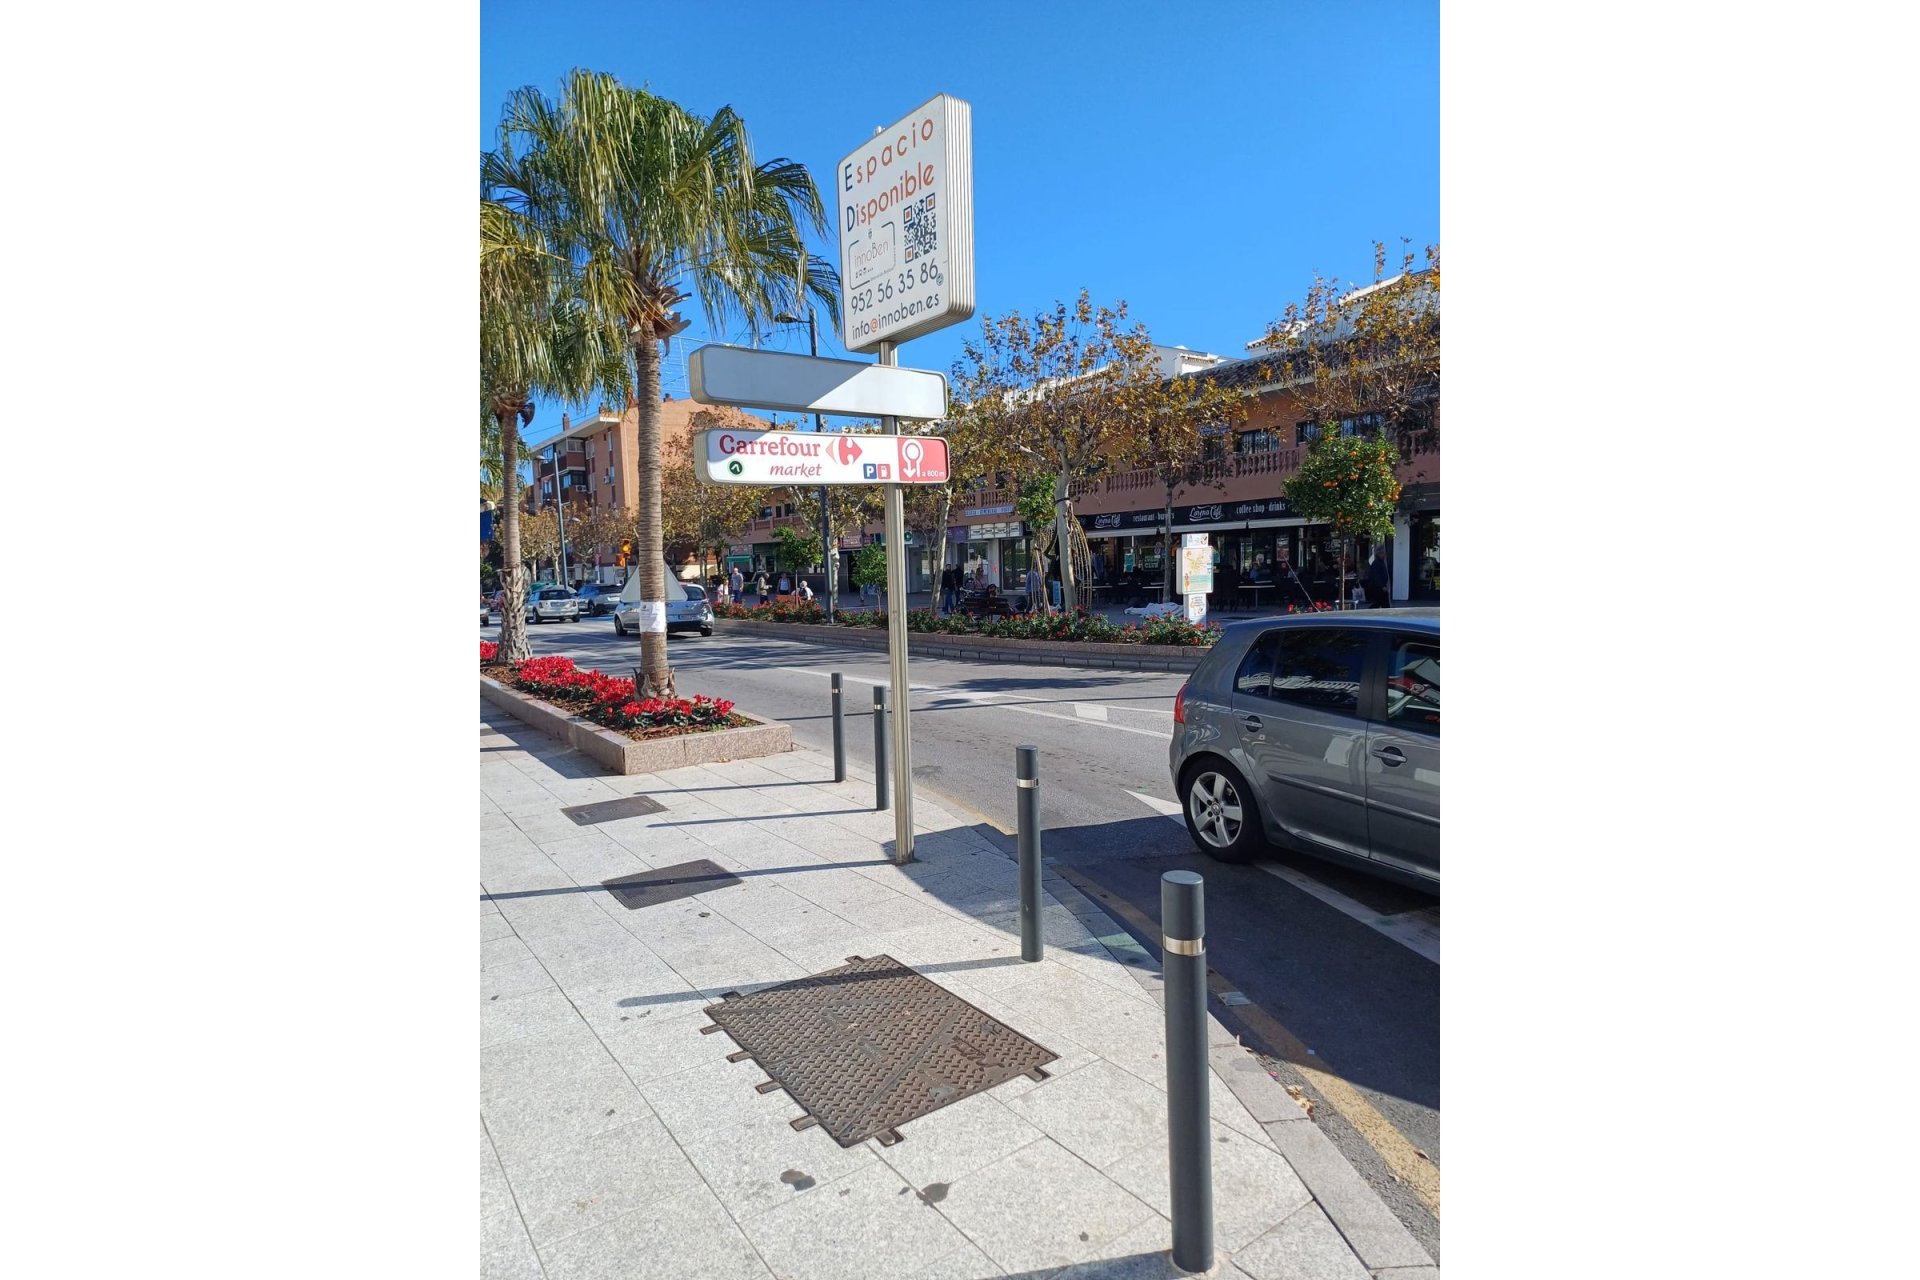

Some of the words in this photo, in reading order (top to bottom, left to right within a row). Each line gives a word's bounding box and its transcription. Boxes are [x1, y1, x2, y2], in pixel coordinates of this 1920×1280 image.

[845, 117, 934, 193] Espacio
[846, 161, 935, 232] Disponible
[854, 240, 889, 268] innoBen
[851, 288, 874, 316] 952
[877, 277, 894, 304] 56
[898, 268, 915, 294] 35
[920, 257, 939, 284] 86
[852, 292, 940, 341] info@innoben.es
[719, 434, 821, 457] Carrefour
[769, 462, 823, 478] market
[866, 465, 875, 478] P
[1252, 503, 1265, 514] shop
[1268, 501, 1286, 512] drinks
